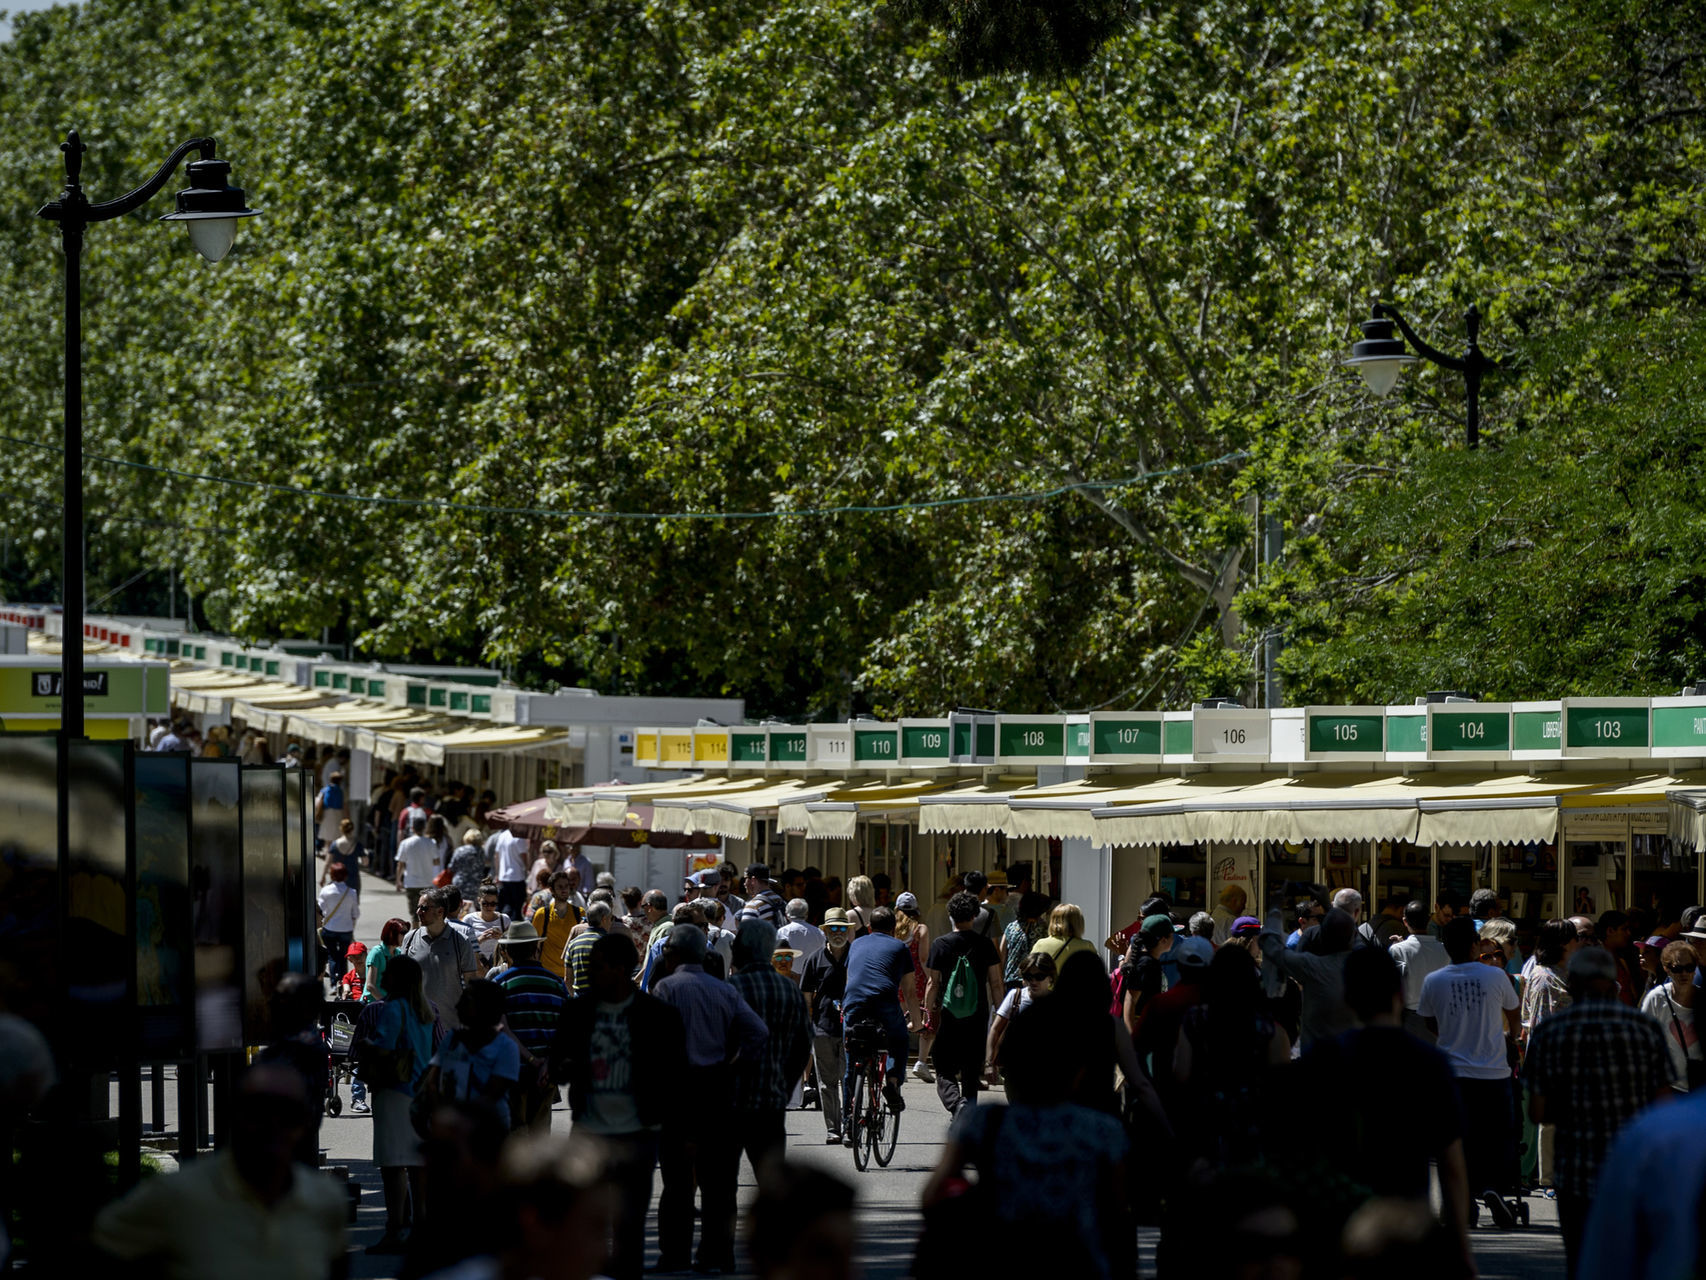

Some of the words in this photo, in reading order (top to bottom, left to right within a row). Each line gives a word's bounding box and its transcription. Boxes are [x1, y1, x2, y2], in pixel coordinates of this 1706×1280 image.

[1117, 729, 1140, 744] 107
[1223, 729, 1246, 744] 106
[1333, 724, 1358, 741] 105
[1459, 722, 1485, 739] 104
[1594, 721, 1621, 738] 103
[787, 740, 805, 753] 112
[921, 734, 941, 748] 109
[1023, 732, 1045, 747] 108
[677, 742, 692, 754] 115
[711, 743, 727, 755] 114
[750, 741, 767, 754] 113
[829, 741, 846, 753] 111
[872, 740, 890, 754] 110
